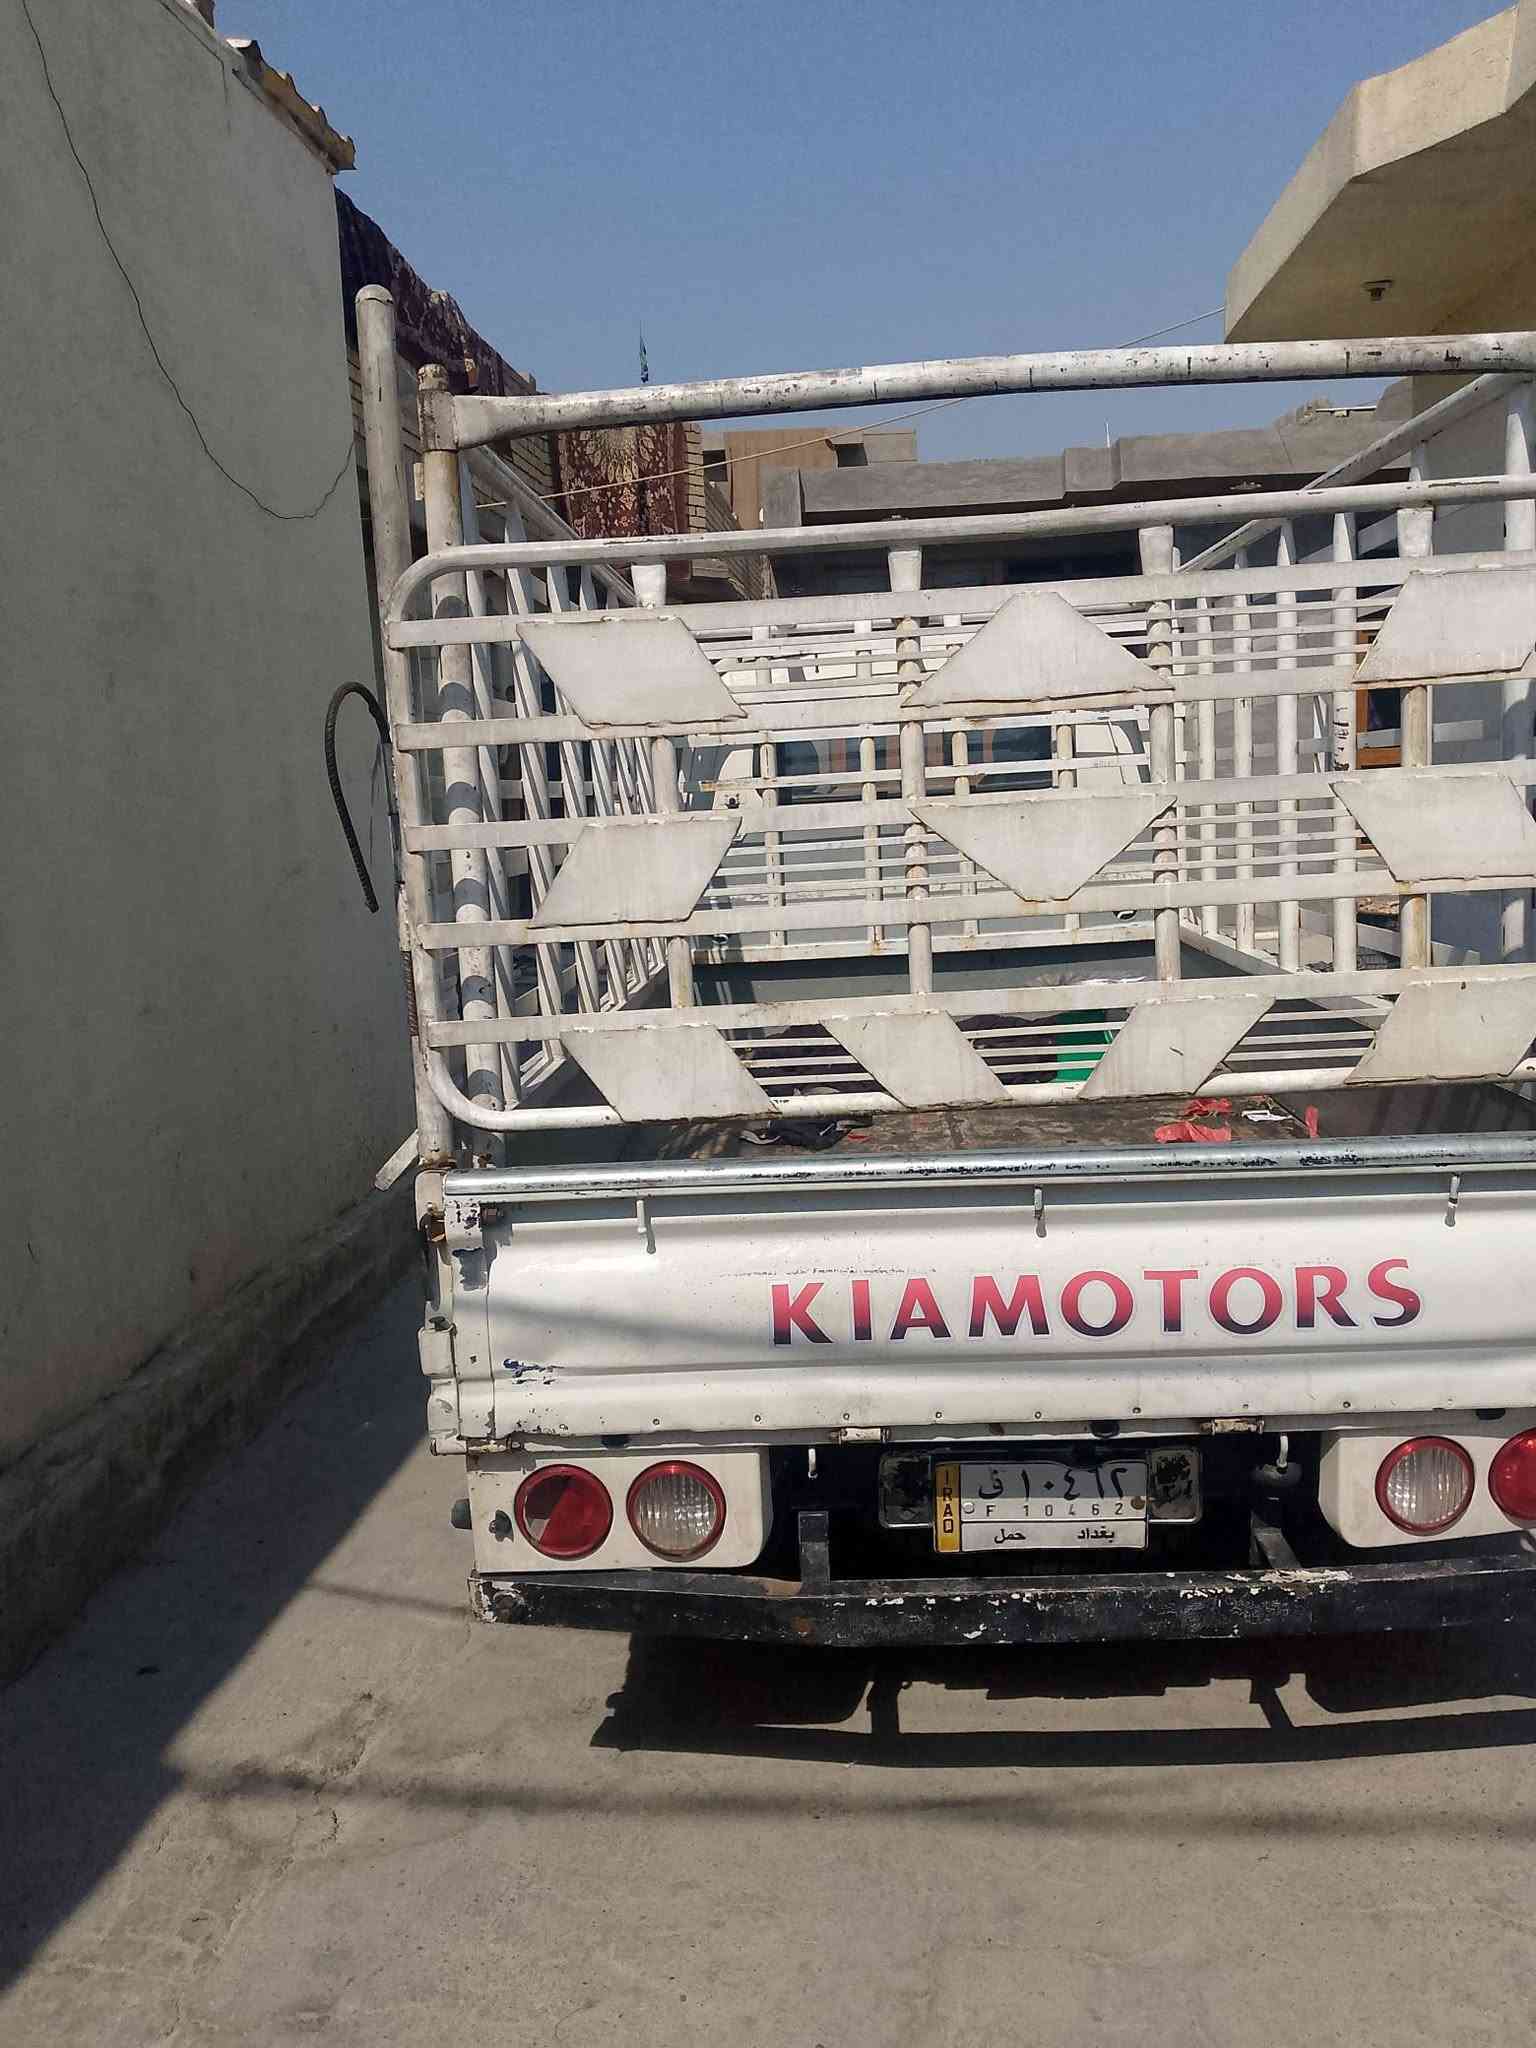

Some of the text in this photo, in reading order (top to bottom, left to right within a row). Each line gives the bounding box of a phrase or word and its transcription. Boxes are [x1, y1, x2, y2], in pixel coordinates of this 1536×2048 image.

[942, 1470, 954, 1534] IRAQ
[985, 1502, 1124, 1517] F 10462
[993, 1525, 1116, 1545] بغداد حمل
